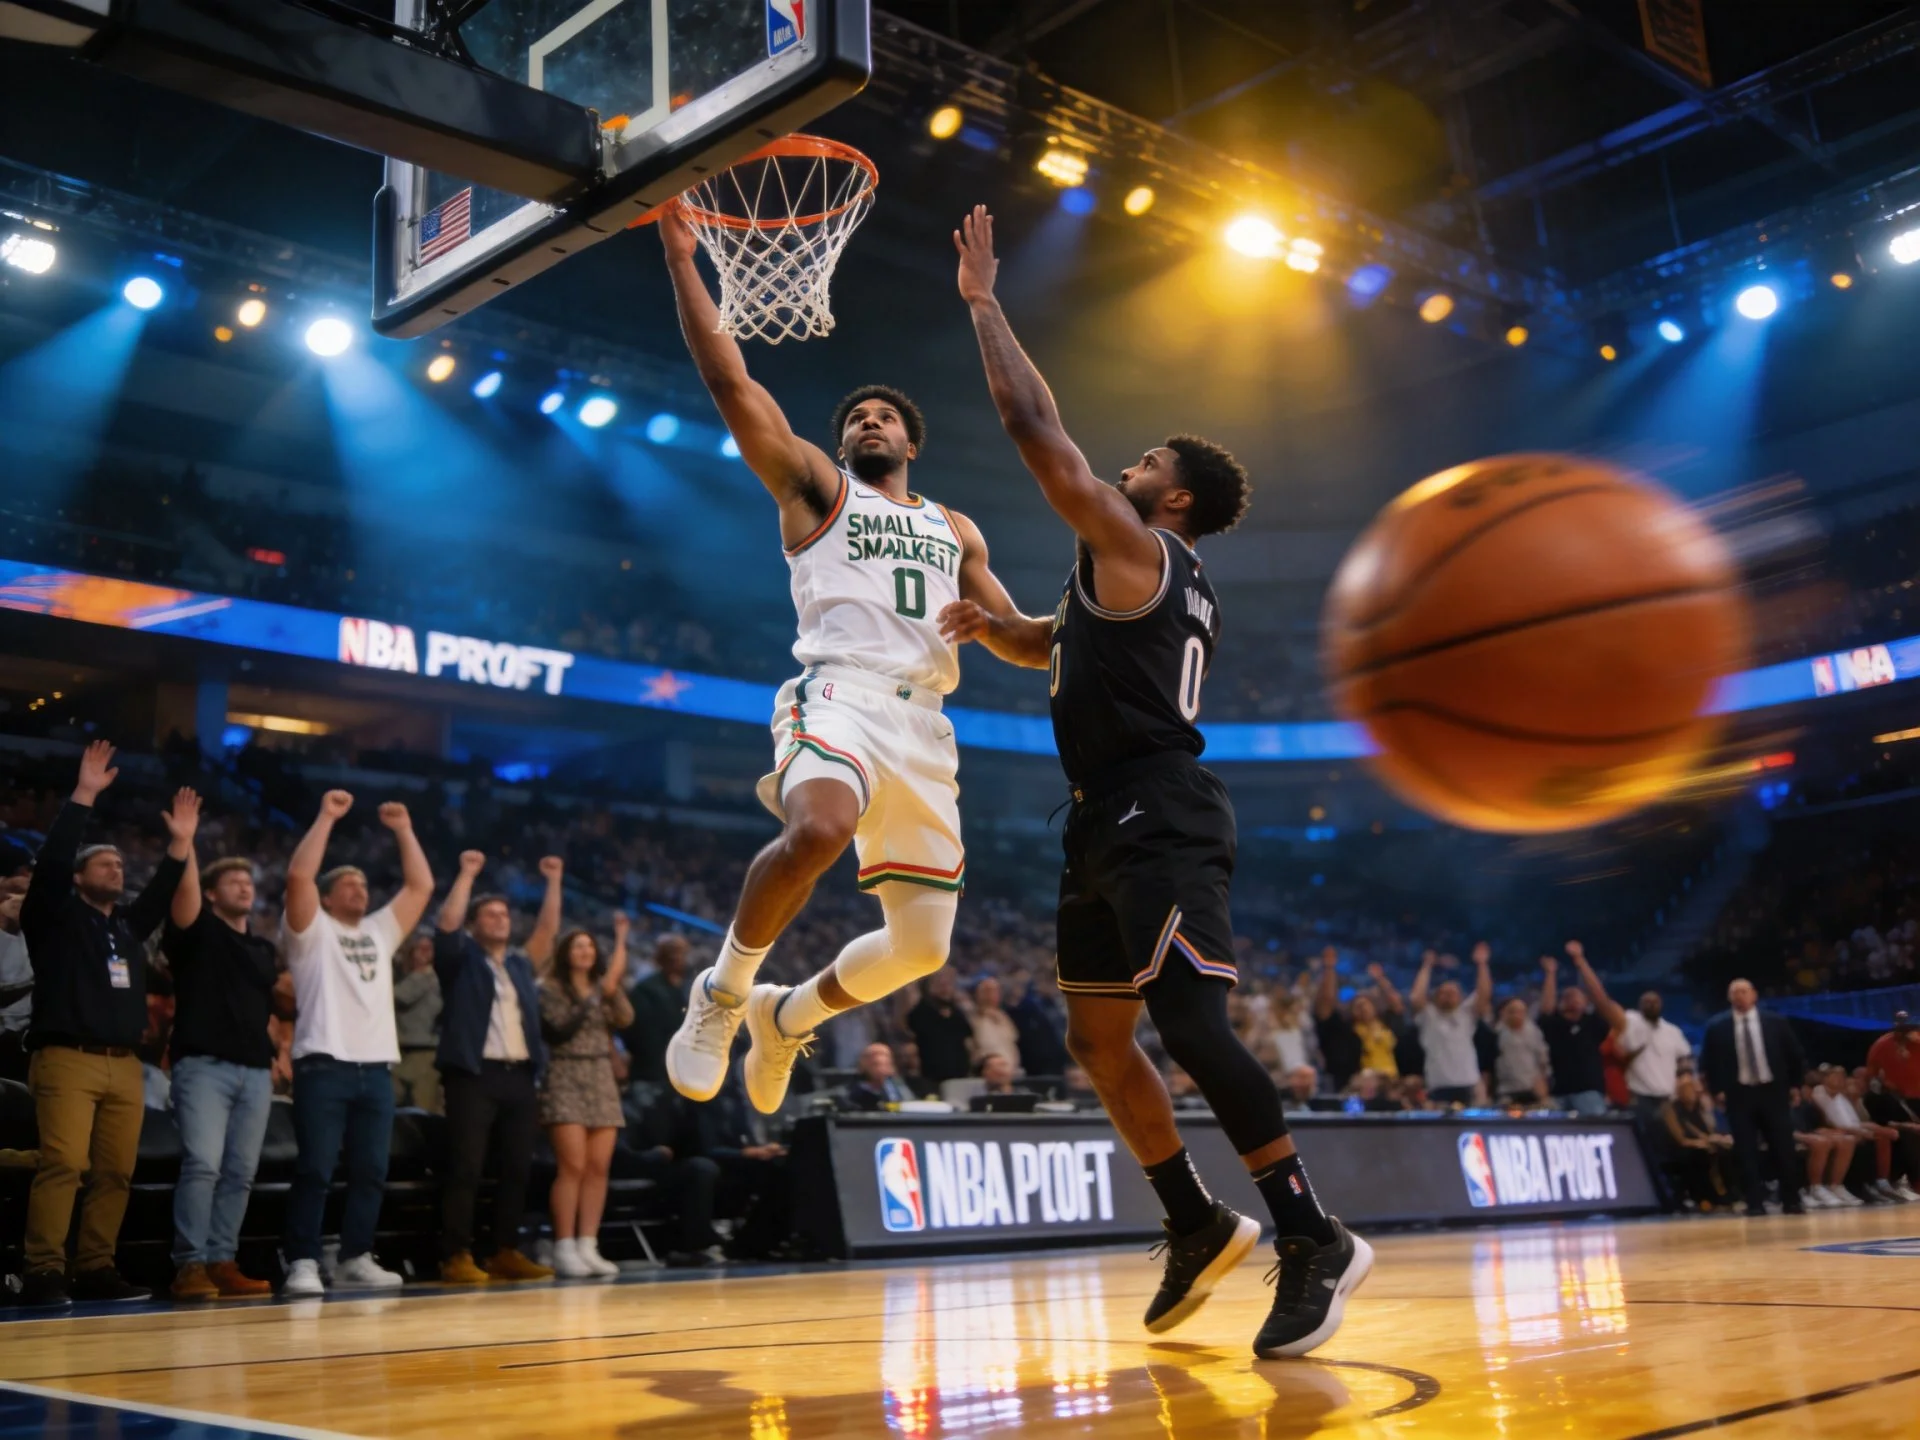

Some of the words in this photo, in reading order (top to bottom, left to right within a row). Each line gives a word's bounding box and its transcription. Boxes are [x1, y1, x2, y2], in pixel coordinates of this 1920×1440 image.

[892, 567, 926, 620] 0
[338, 616, 418, 674] NBA
[1179, 636, 1204, 721] 0
[924, 1141, 1014, 1229] NBA
[1488, 1134, 1551, 1206] NBA
